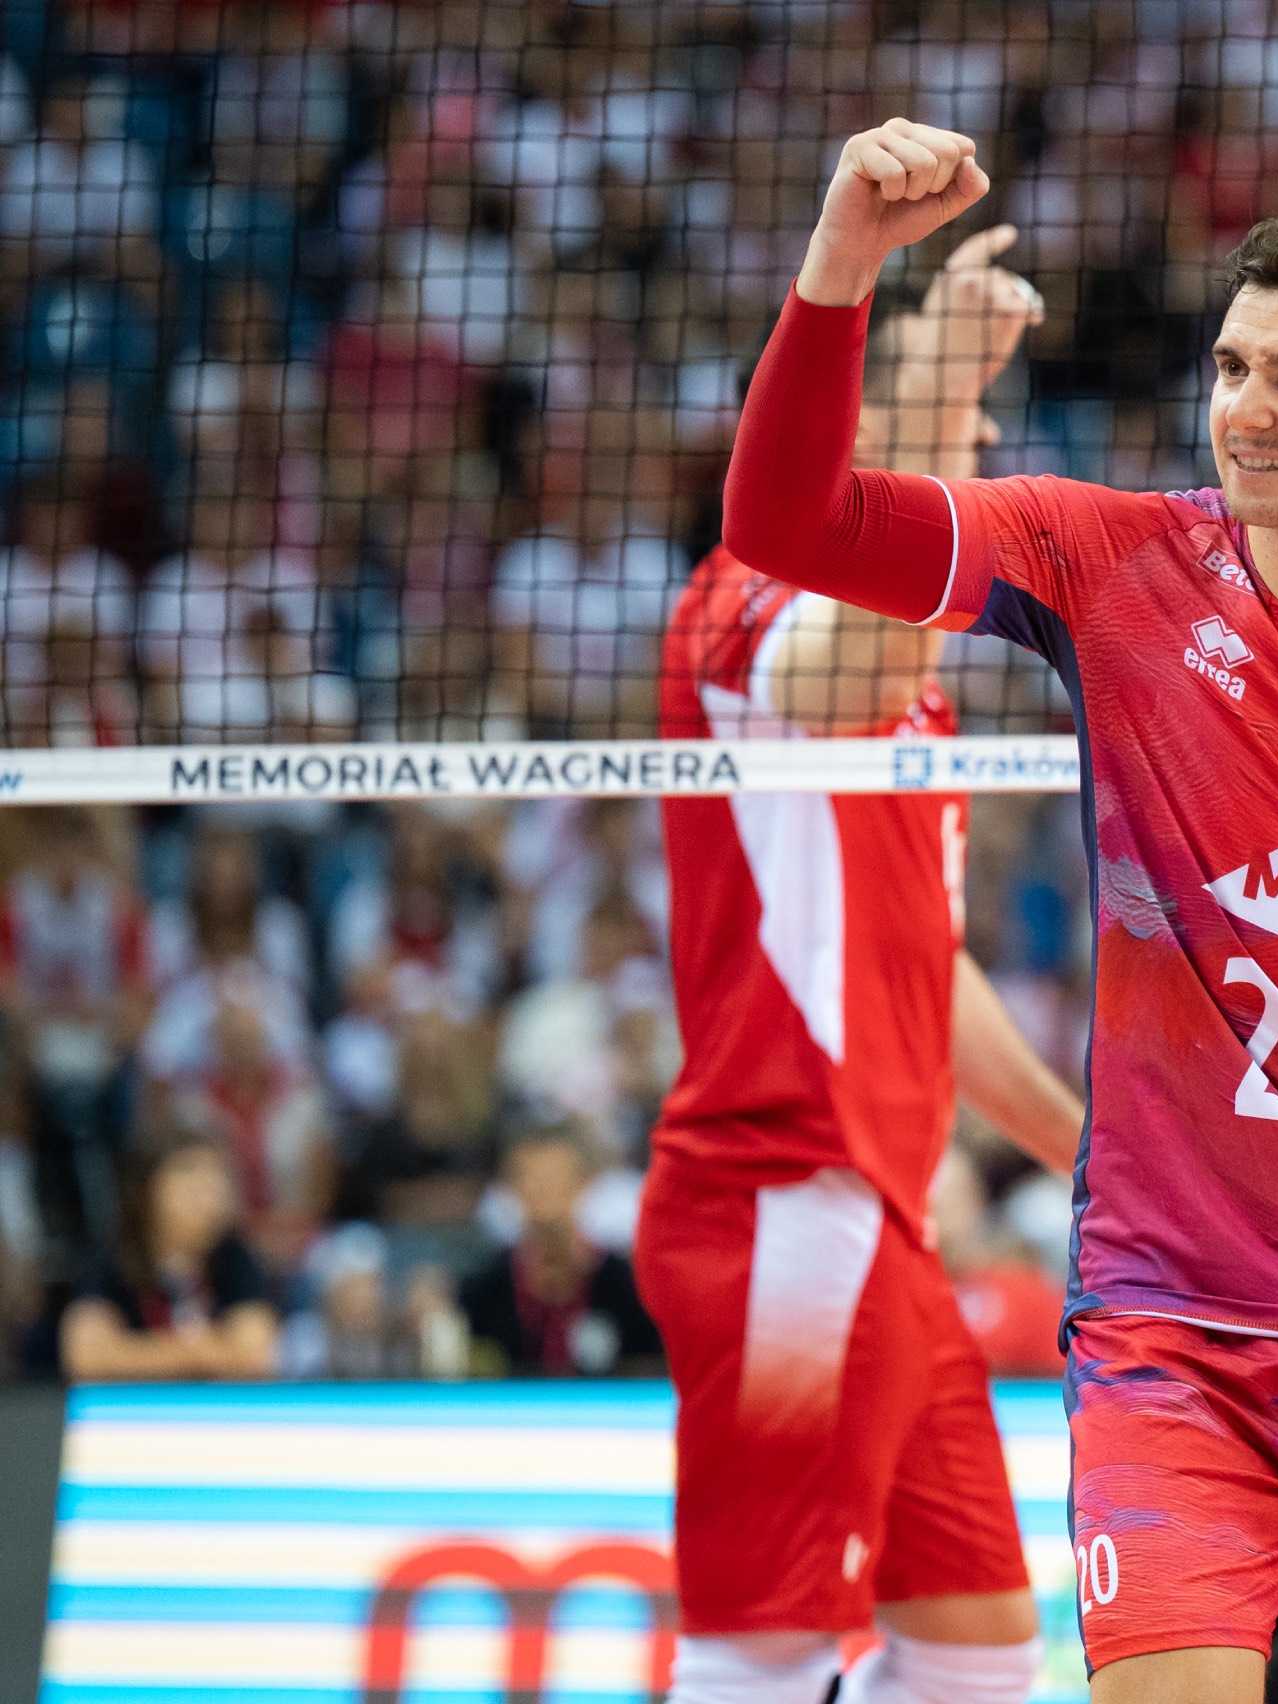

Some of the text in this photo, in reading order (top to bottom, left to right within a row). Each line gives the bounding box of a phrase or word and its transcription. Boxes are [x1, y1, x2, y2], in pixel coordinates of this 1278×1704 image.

[1183, 647, 1247, 701] errea
[172, 752, 741, 793] MEMORIAŁ WAGNERA
[1077, 1533, 1119, 1617] 20
